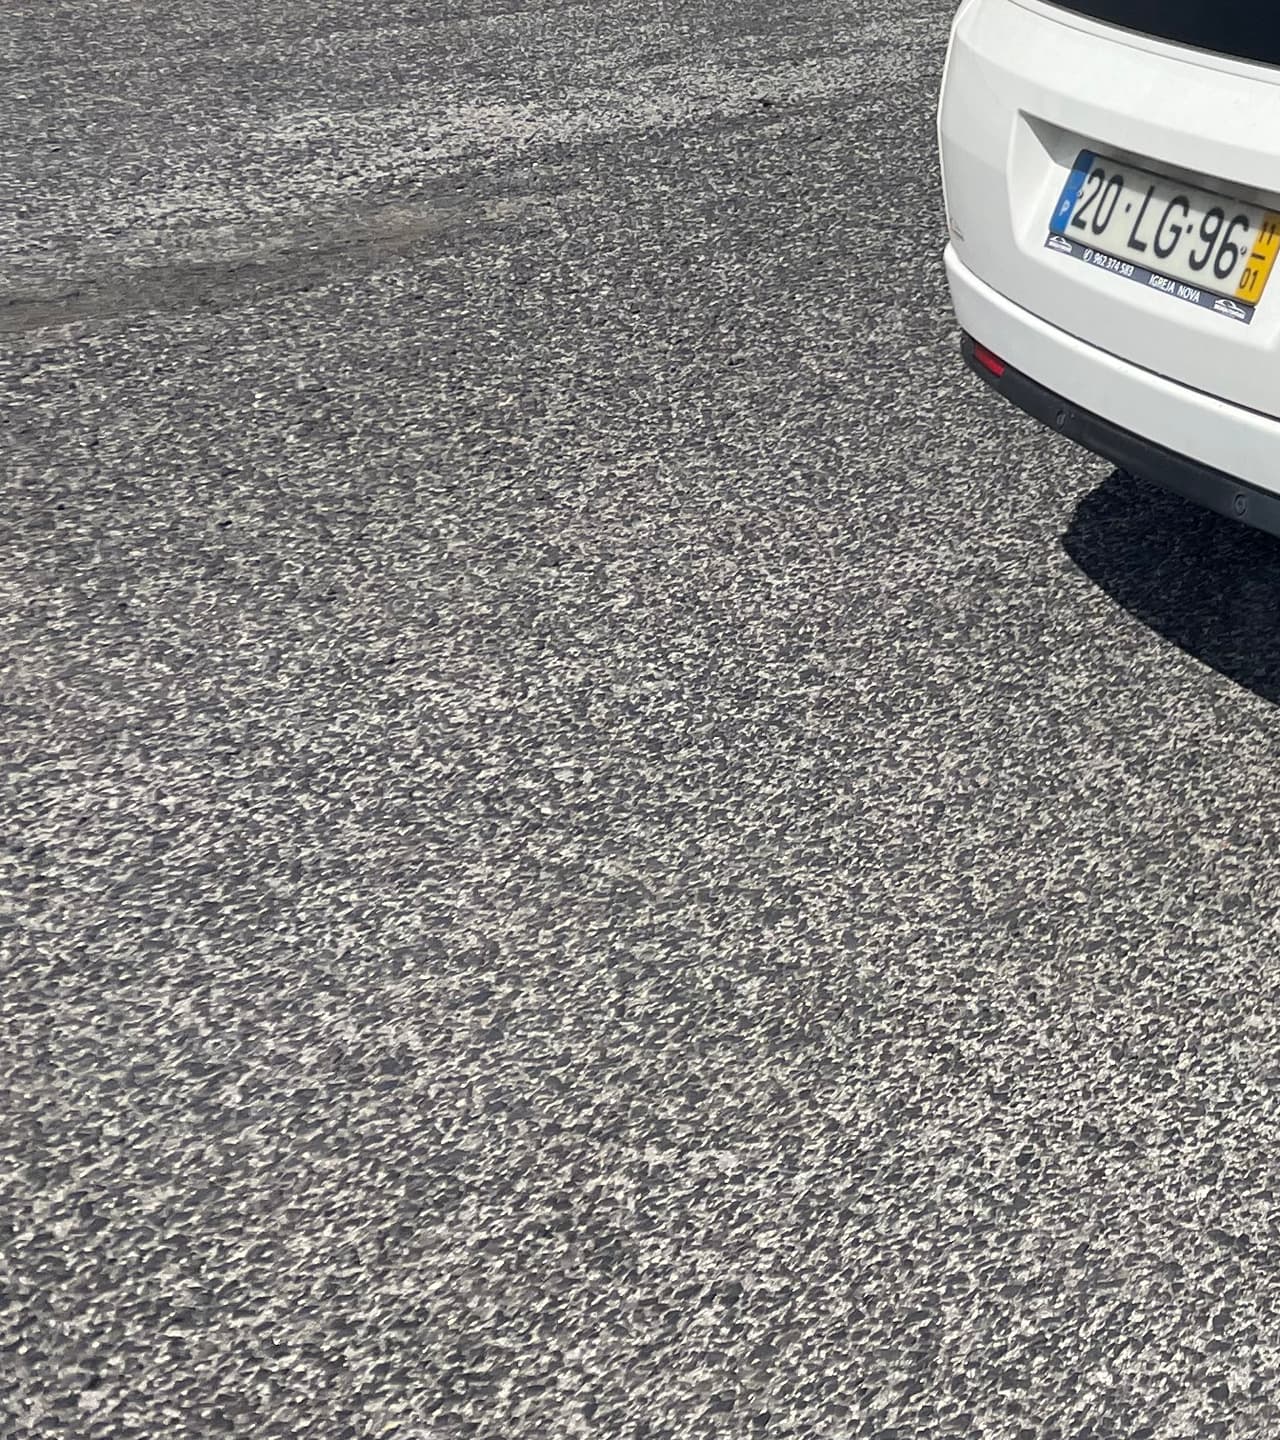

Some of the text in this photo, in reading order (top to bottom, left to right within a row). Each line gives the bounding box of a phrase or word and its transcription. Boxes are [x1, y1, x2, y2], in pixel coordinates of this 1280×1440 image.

[1058, 199, 1070, 216] P
[1259, 221, 1276, 245] 11
[1148, 274, 1175, 294] IGREJA
[1177, 285, 1201, 303] NOVA
[1239, 267, 1258, 292] 01
